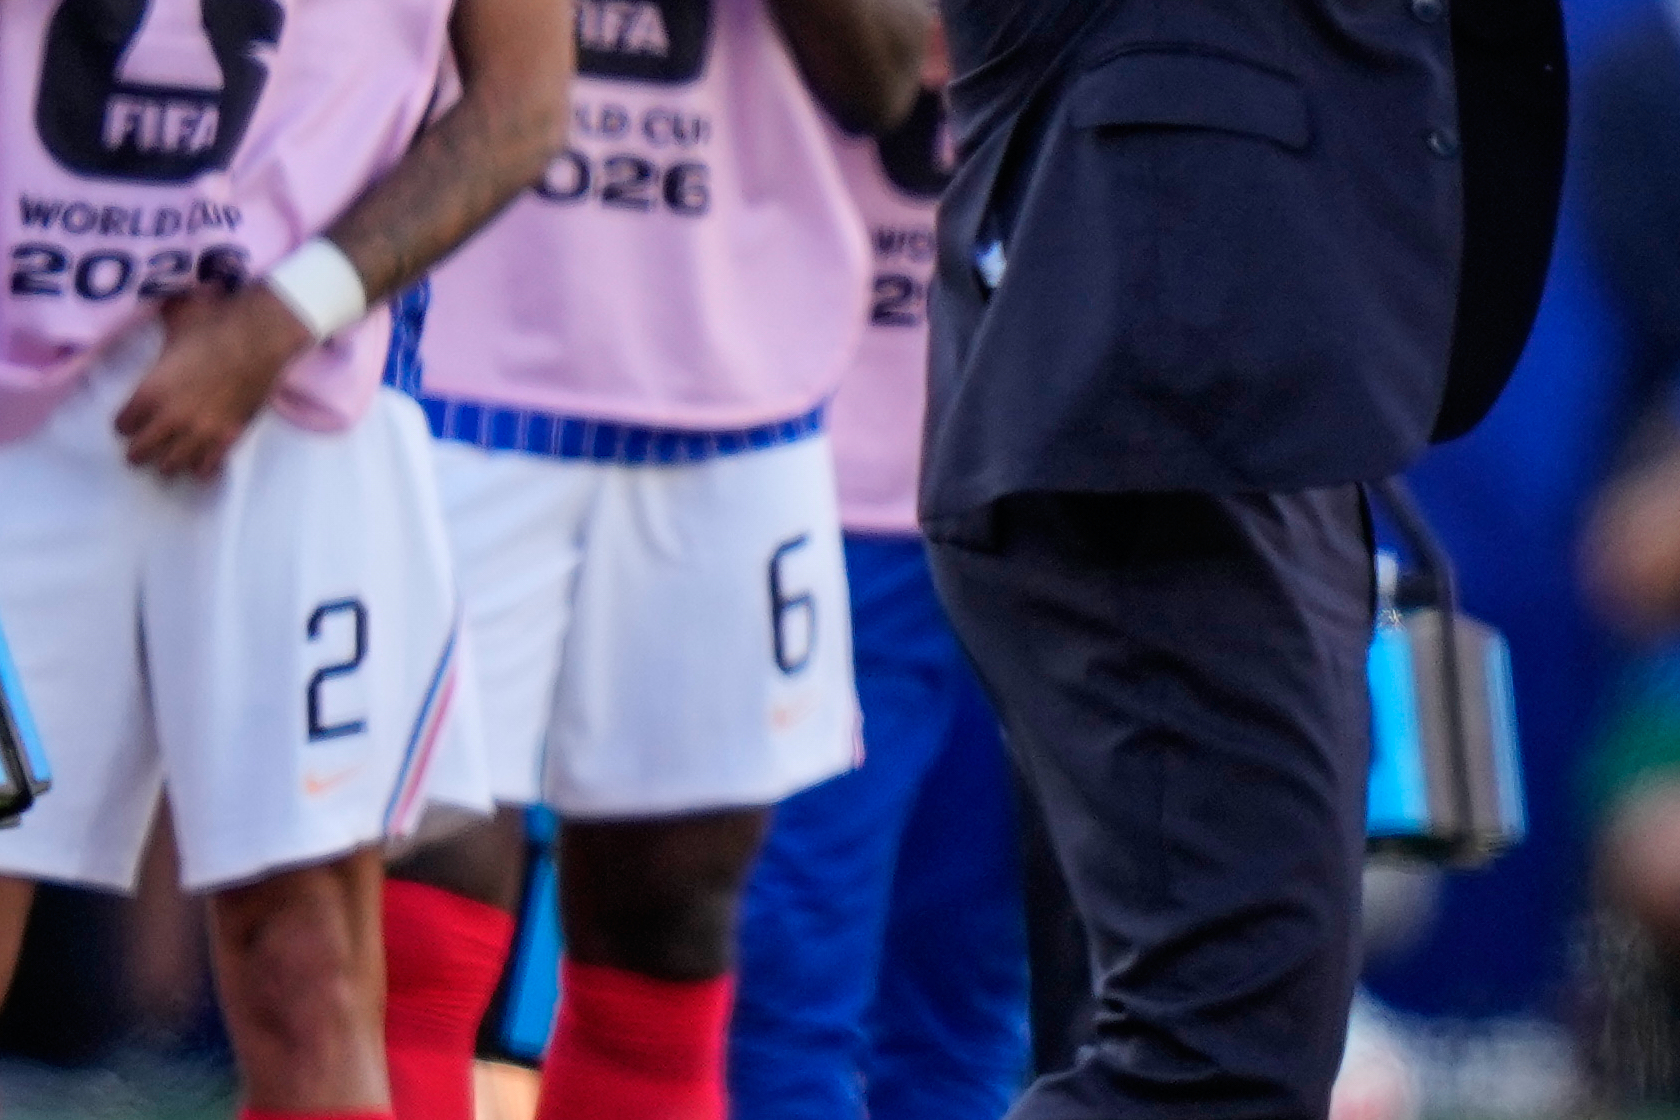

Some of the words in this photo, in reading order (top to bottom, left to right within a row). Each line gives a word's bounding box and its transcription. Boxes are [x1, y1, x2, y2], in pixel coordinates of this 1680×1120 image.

[102, 94, 220, 153] FIFA
[18, 191, 183, 237] WORLD
[534, 149, 711, 219] 026
[767, 531, 819, 676] 6
[304, 594, 371, 743] 2
